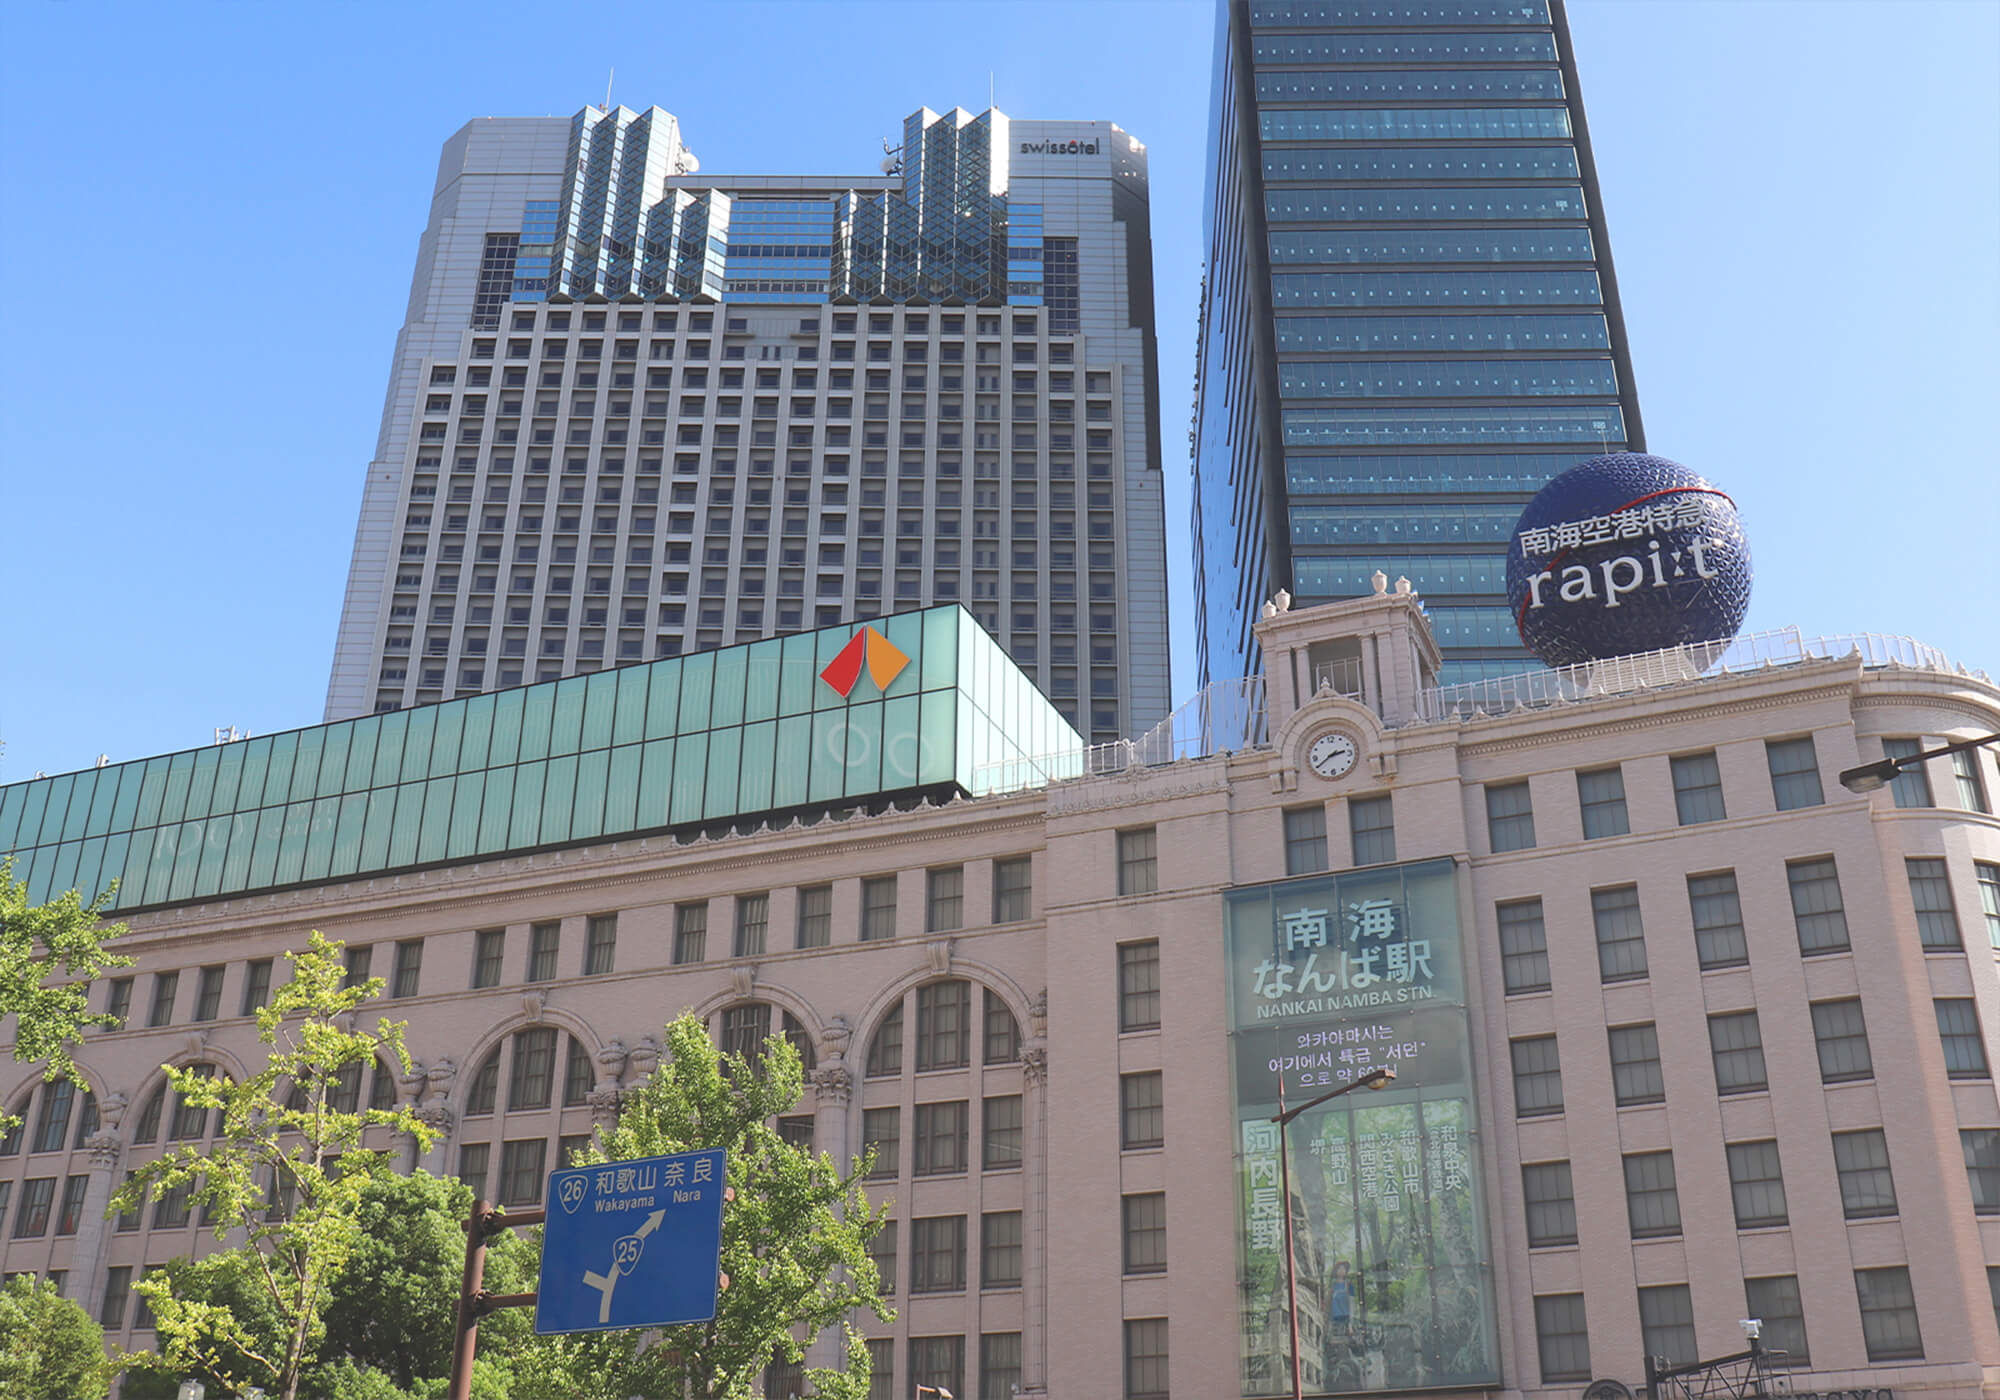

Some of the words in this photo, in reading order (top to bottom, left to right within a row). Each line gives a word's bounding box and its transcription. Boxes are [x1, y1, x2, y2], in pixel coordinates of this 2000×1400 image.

[1021, 138, 1100, 155] swissôtel
[1518, 502, 1705, 559] 南海空港特急
[1282, 898, 1395, 952] 南海
[1253, 939, 1435, 999] なんば駅
[1257, 1000, 1323, 1019] NANKAI
[1327, 992, 1392, 1011] NAMBA
[1397, 985, 1437, 1001] STN.
[1297, 1025, 1394, 1048] 와카야마시는
[1268, 1051, 1332, 1072] 여기에서
[1338, 1047, 1371, 1064] 특급
[1298, 1071, 1332, 1087] 으로
[1336, 1068, 1353, 1083] 약
[595, 1165, 657, 1196] 和歌山
[664, 1157, 713, 1188] 奈良
[1359, 1134, 1379, 1198] 関西空港
[1380, 1131, 1400, 1212] みさき公園
[1400, 1129, 1420, 1195] 和歌山市
[1441, 1125, 1463, 1191] 和泉中央
[563, 1179, 582, 1202] 26
[595, 1195, 655, 1214] Wakayama
[673, 1188, 702, 1203] Nara
[1247, 1127, 1282, 1251] 河内長野
[617, 1240, 638, 1264] 25
